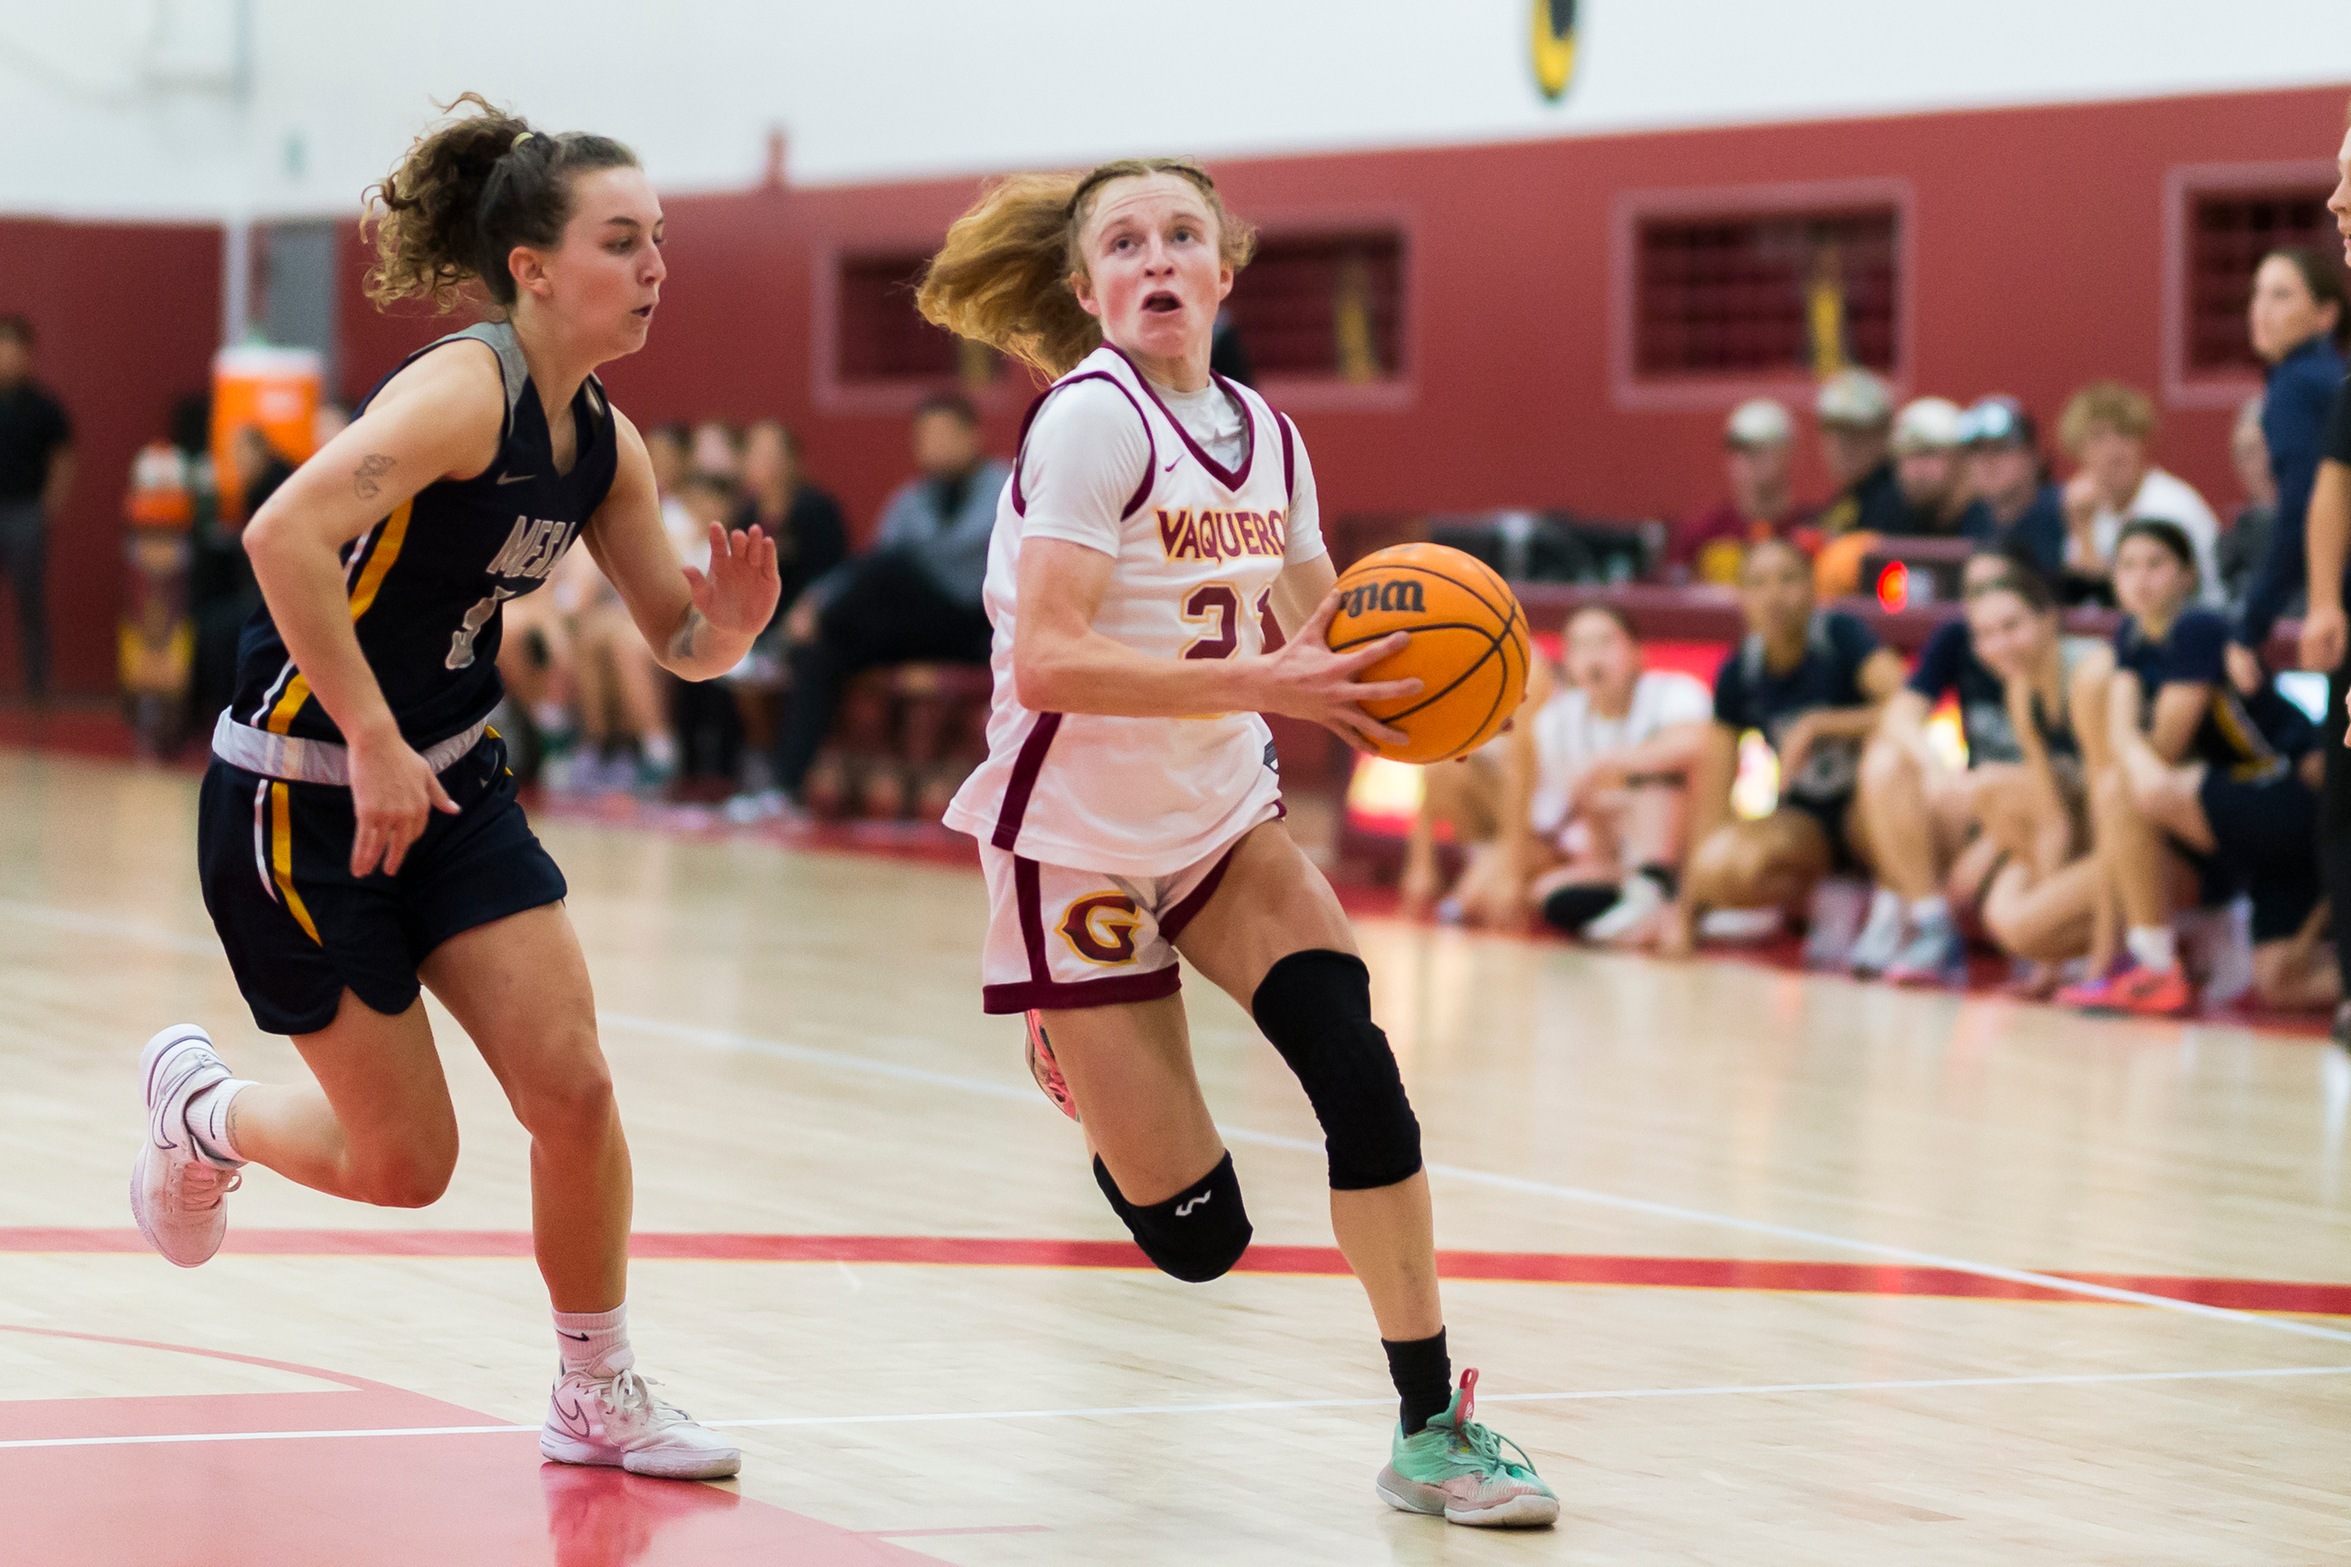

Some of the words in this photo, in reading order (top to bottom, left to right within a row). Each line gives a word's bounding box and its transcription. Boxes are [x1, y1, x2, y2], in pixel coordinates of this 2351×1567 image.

[1152, 505, 1288, 564] VAQUERO
[1178, 580, 1271, 660] 2
[1053, 889, 1144, 966] G
